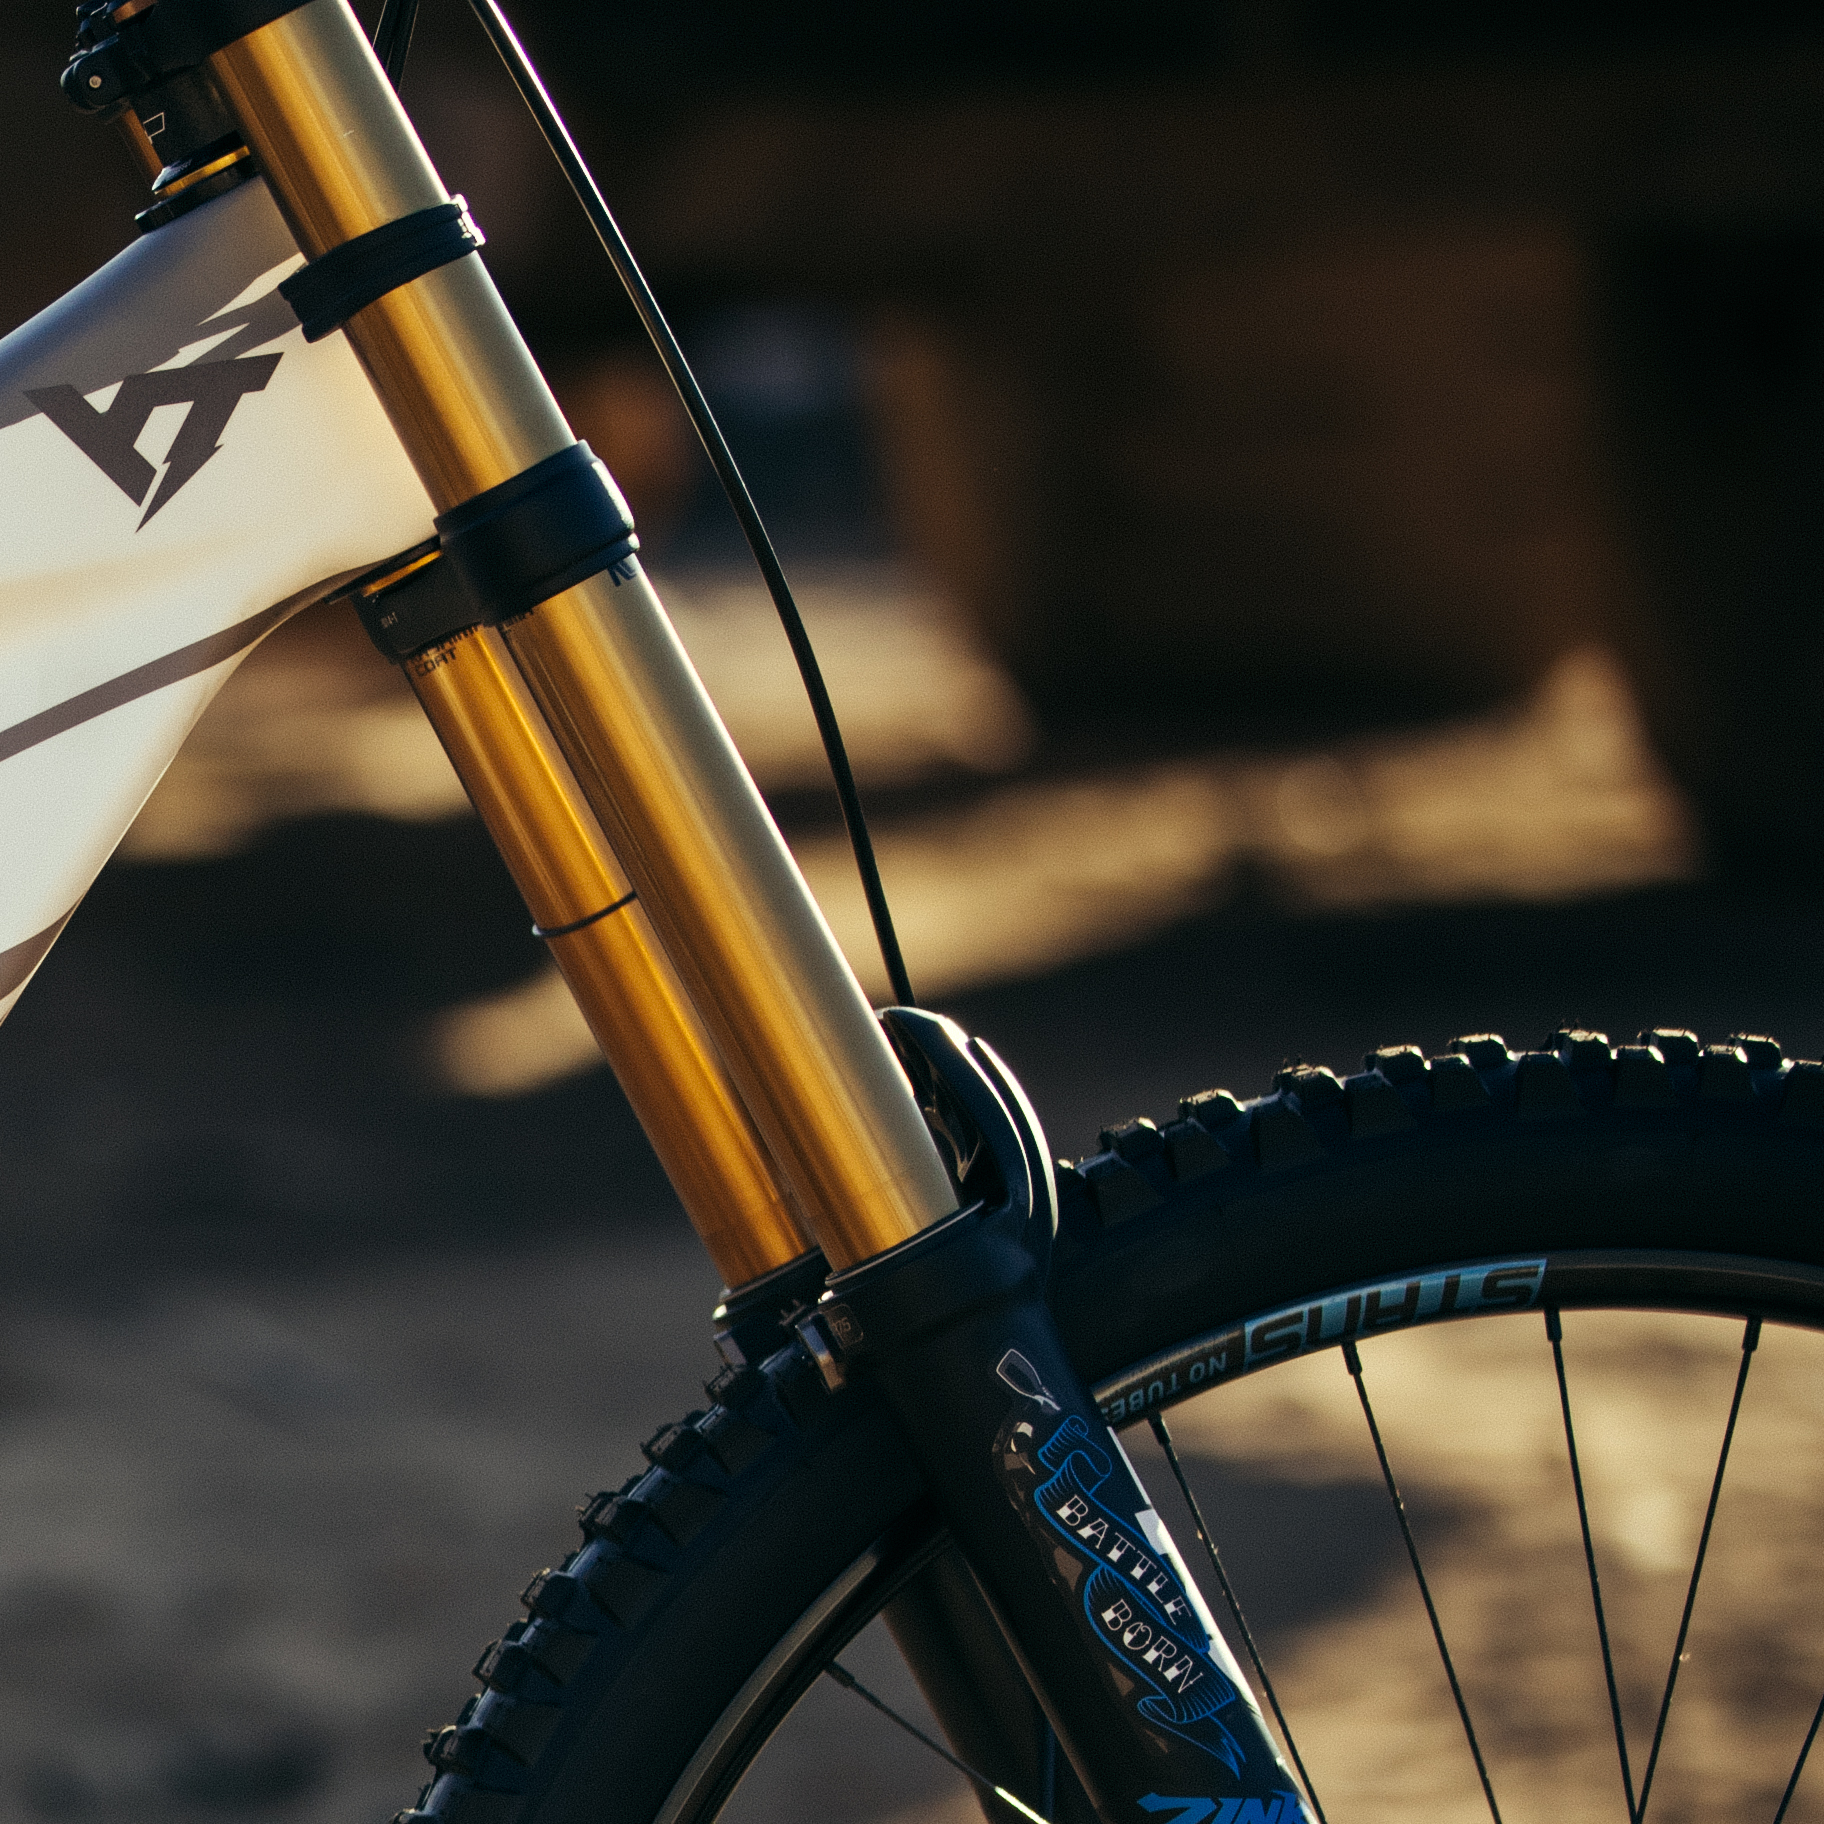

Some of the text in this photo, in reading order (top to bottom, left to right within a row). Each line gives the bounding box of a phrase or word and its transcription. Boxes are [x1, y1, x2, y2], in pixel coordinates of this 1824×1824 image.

[1189, 1352, 1227, 1383] NO
[1055, 1494, 1195, 1629] BATTLE
[1100, 1598, 1205, 1697] BORN
